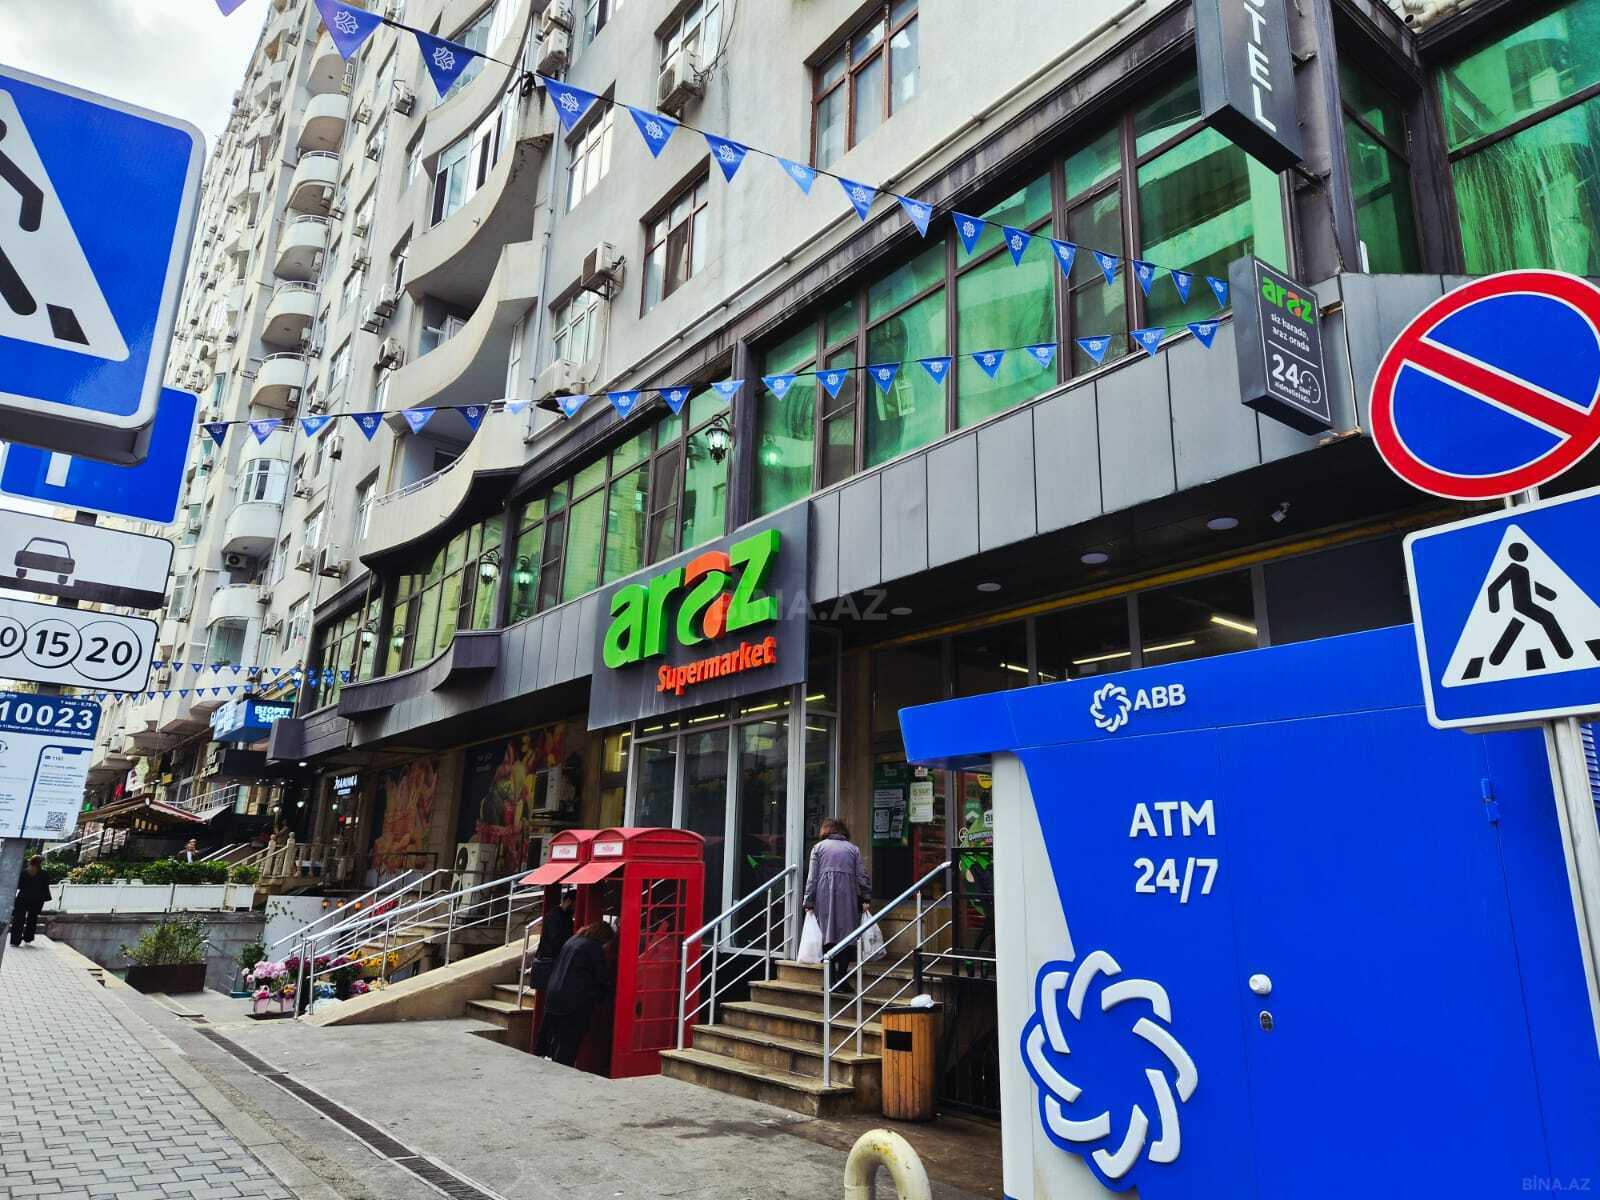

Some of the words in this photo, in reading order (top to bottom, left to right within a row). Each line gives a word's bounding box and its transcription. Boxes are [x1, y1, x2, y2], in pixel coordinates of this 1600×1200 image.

[1262, 276, 1313, 325] araz
[1272, 353, 1300, 388] 24
[602, 528, 781, 670] araz
[36, 629, 71, 658] 15
[85, 636, 133, 666] 20
[655, 636, 777, 697] Supermarket
[0, 700, 93, 730] 10023
[1134, 683, 1186, 711] ABB
[1129, 800, 1216, 837] ATM
[1133, 857, 1218, 903] 24/7
